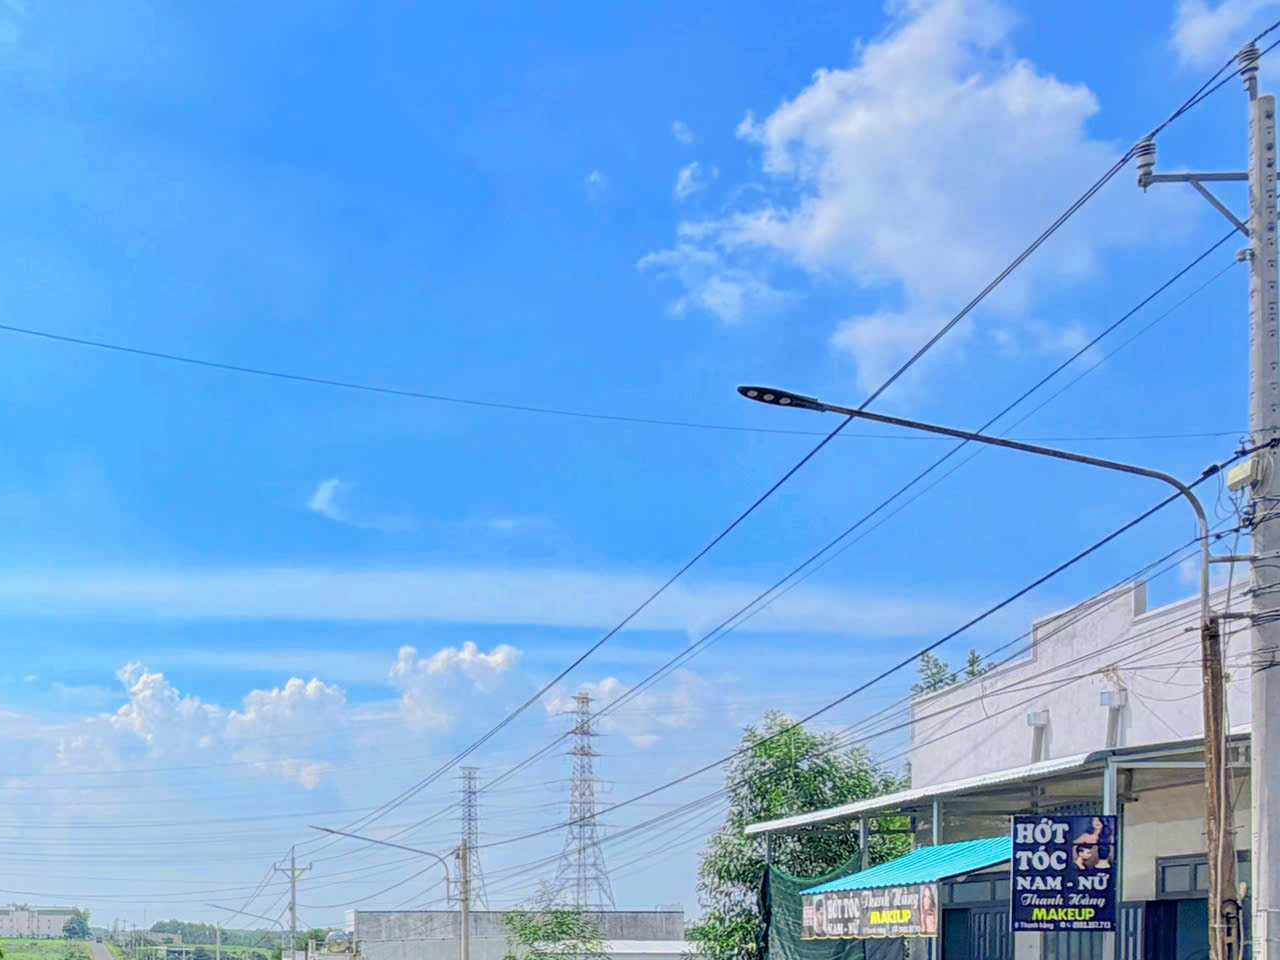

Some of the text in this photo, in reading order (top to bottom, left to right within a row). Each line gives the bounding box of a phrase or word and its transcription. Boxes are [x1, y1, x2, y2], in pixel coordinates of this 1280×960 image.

[1016, 817, 1070, 844] HỚT
[1016, 845, 1068, 871] TÓC
[1016, 876, 1063, 890] NAM
[1077, 872, 1110, 890] NỮ
[1020, 893, 1064, 906] Thanh
[869, 909, 912, 925] MAKEUP
[1031, 908, 1096, 920] MAKEUP
